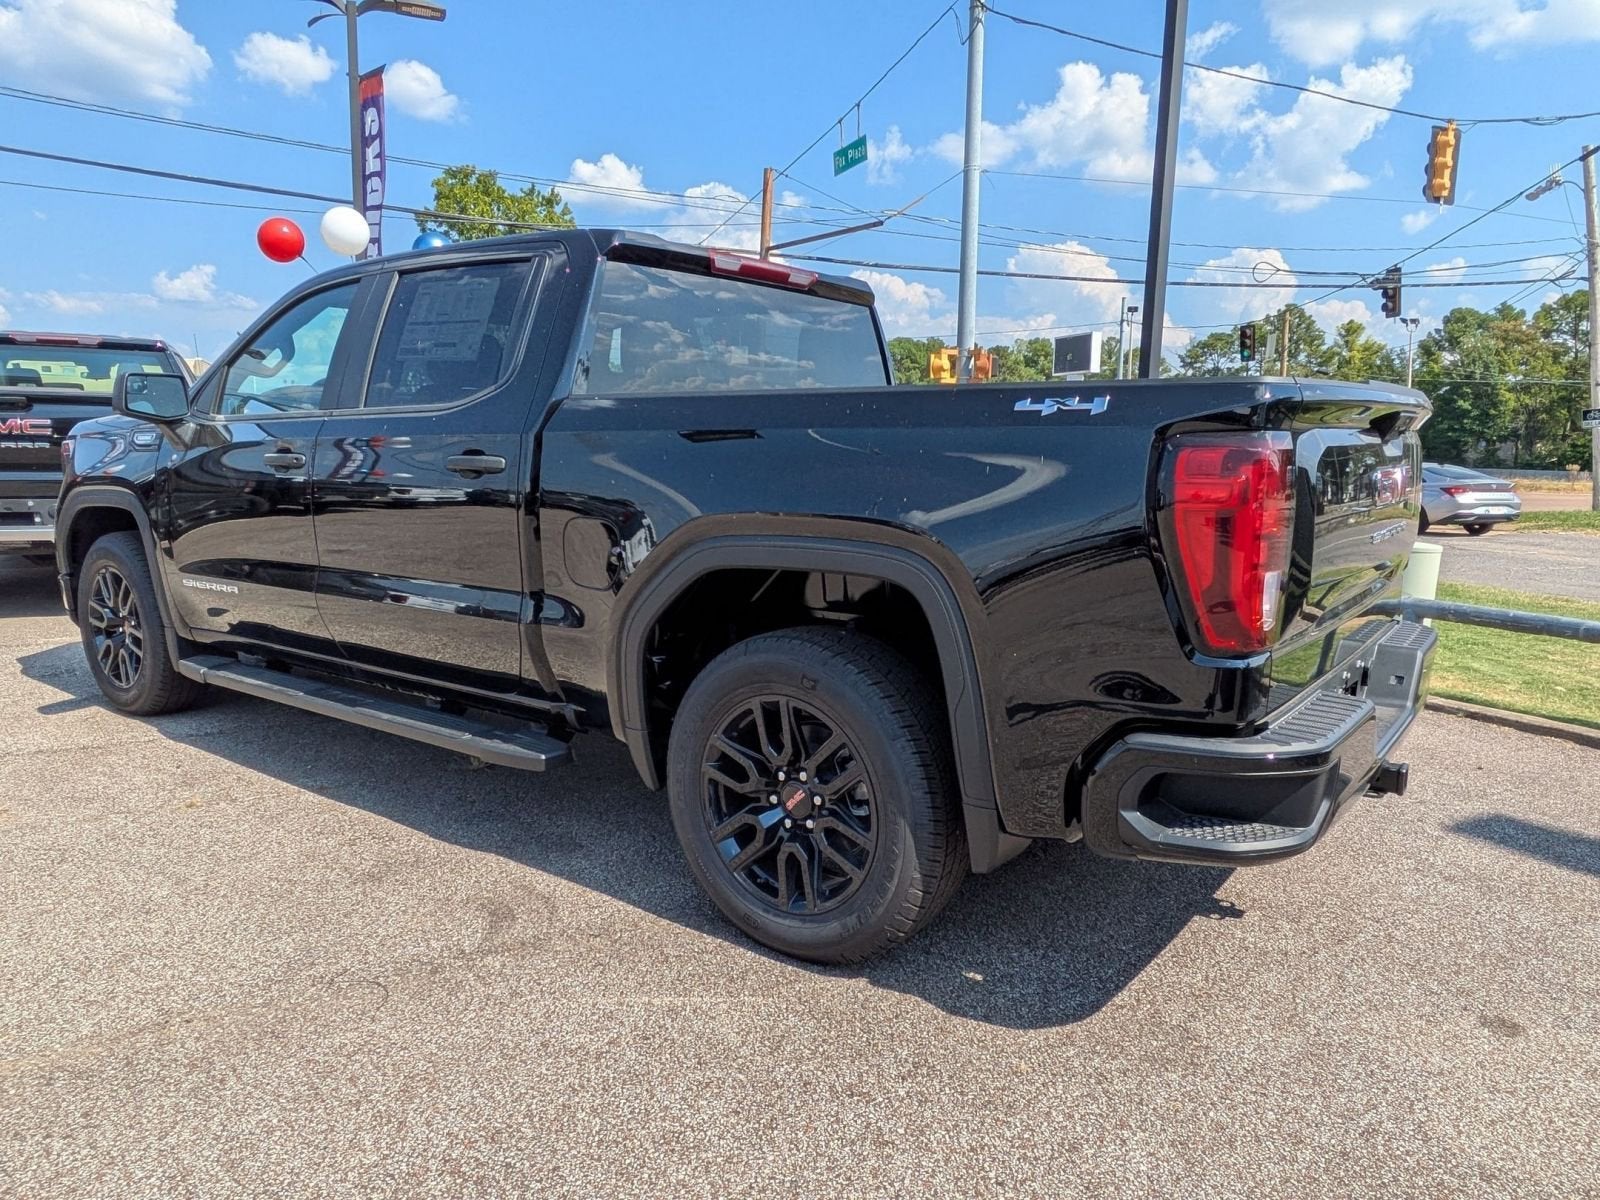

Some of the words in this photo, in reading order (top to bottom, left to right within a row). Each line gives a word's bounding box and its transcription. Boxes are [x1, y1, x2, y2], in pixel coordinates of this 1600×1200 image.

[847, 144, 866, 164] Plaza
[0, 416, 53, 435] MC
[182, 578, 239, 594] SIERRA
